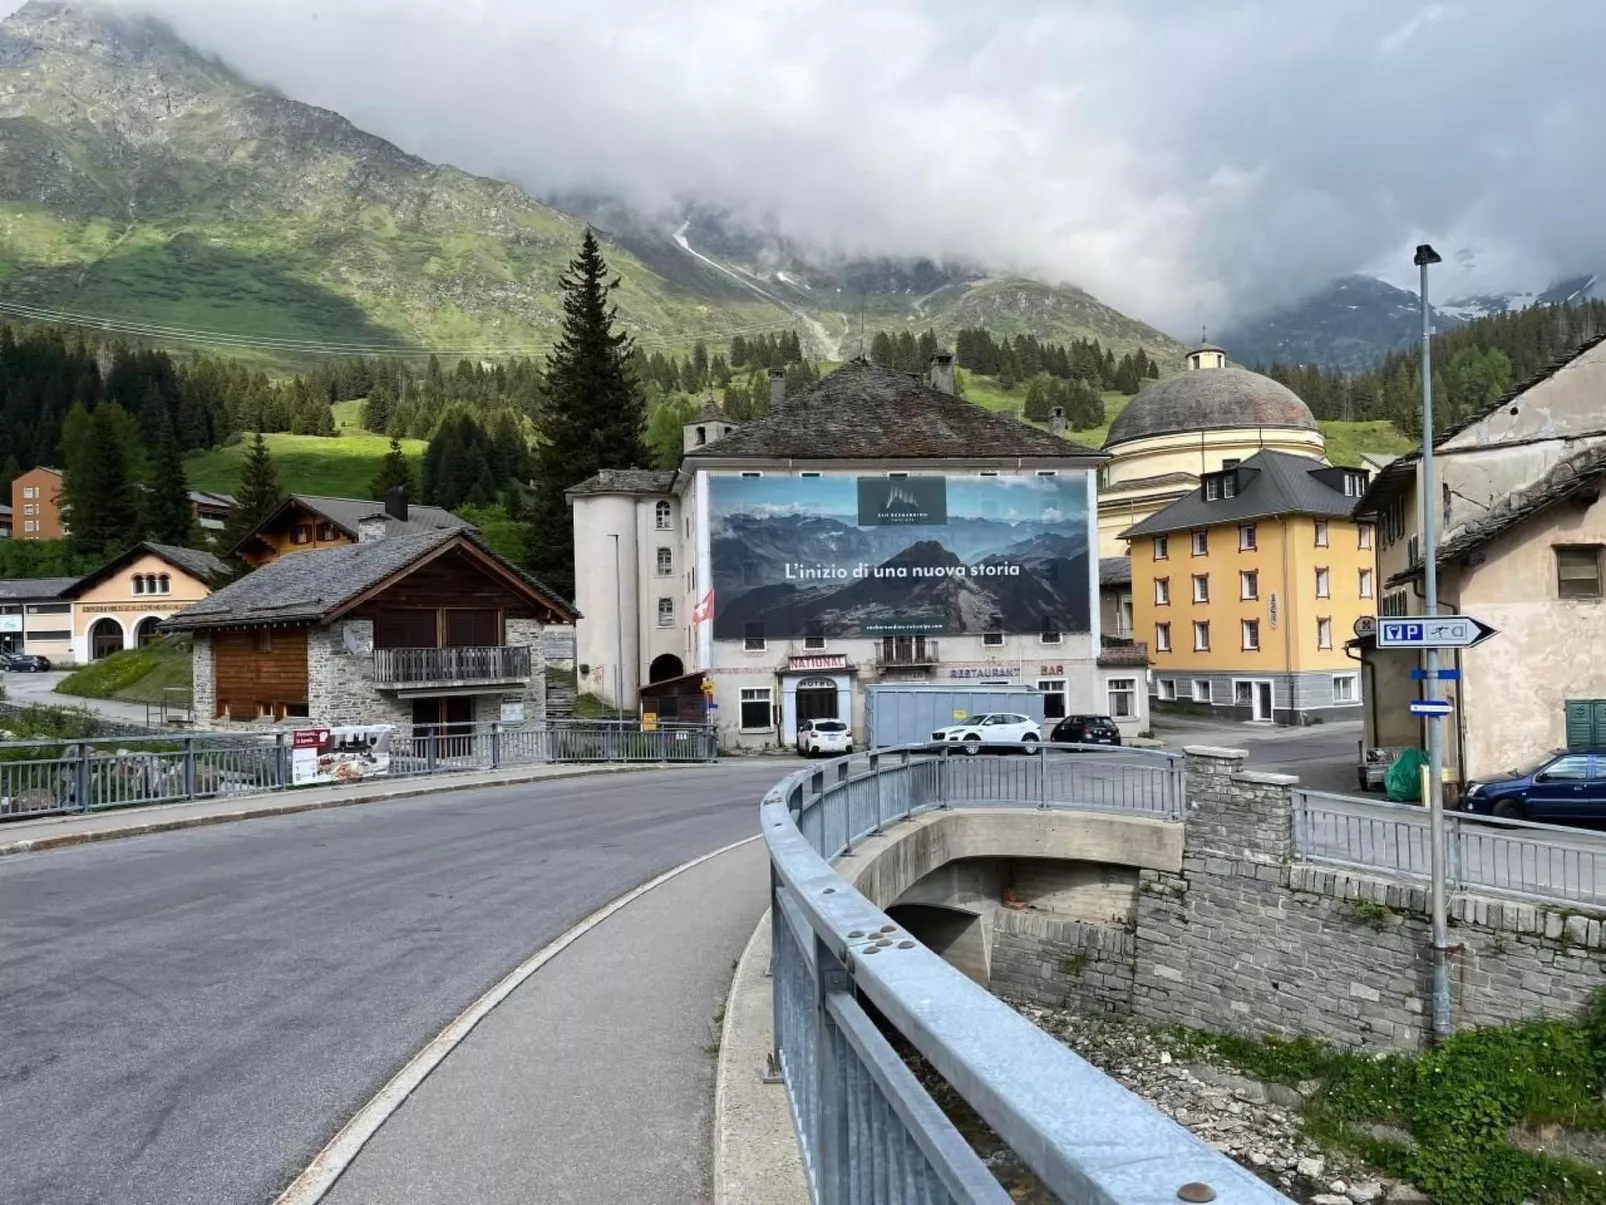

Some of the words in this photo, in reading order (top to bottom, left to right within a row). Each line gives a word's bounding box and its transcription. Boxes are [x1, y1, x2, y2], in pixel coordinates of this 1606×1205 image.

[785, 563, 848, 579] L'inizio
[852, 562, 869, 578] di
[873, 566, 907, 579] una
[912, 564, 966, 577] nuova
[970, 561, 1020, 577] storia
[1407, 625, 1418, 640] P
[790, 657, 845, 669] NATIONAL
[950, 668, 1020, 679] RESTAURANT
[1040, 665, 1064, 676] BAR
